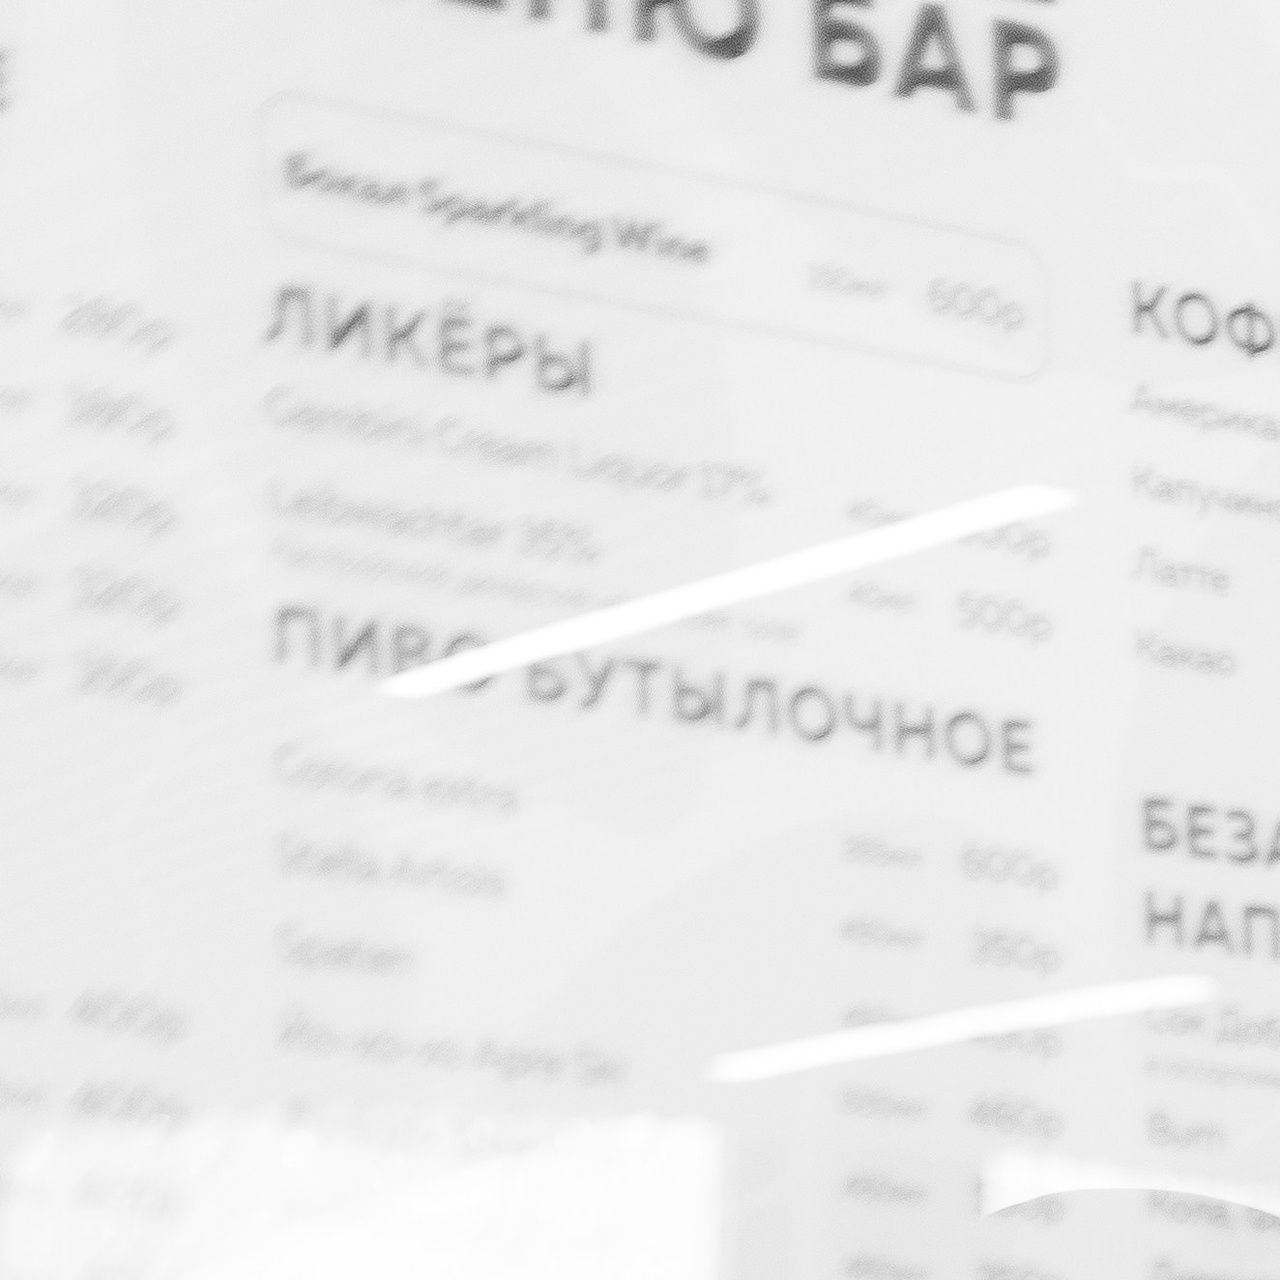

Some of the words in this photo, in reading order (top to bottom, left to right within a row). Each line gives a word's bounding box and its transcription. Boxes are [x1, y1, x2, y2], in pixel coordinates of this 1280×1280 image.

[811, 0, 1059, 122] БАР
[265, 285, 592, 398] ЛИКЁРЫ
[1131, 545, 1230, 596] Латте
[275, 604, 494, 694] ПИВО
[527, 652, 1037, 778] БУТЫЛОЧНОЕ
[1134, 628, 1237, 678] Какао
